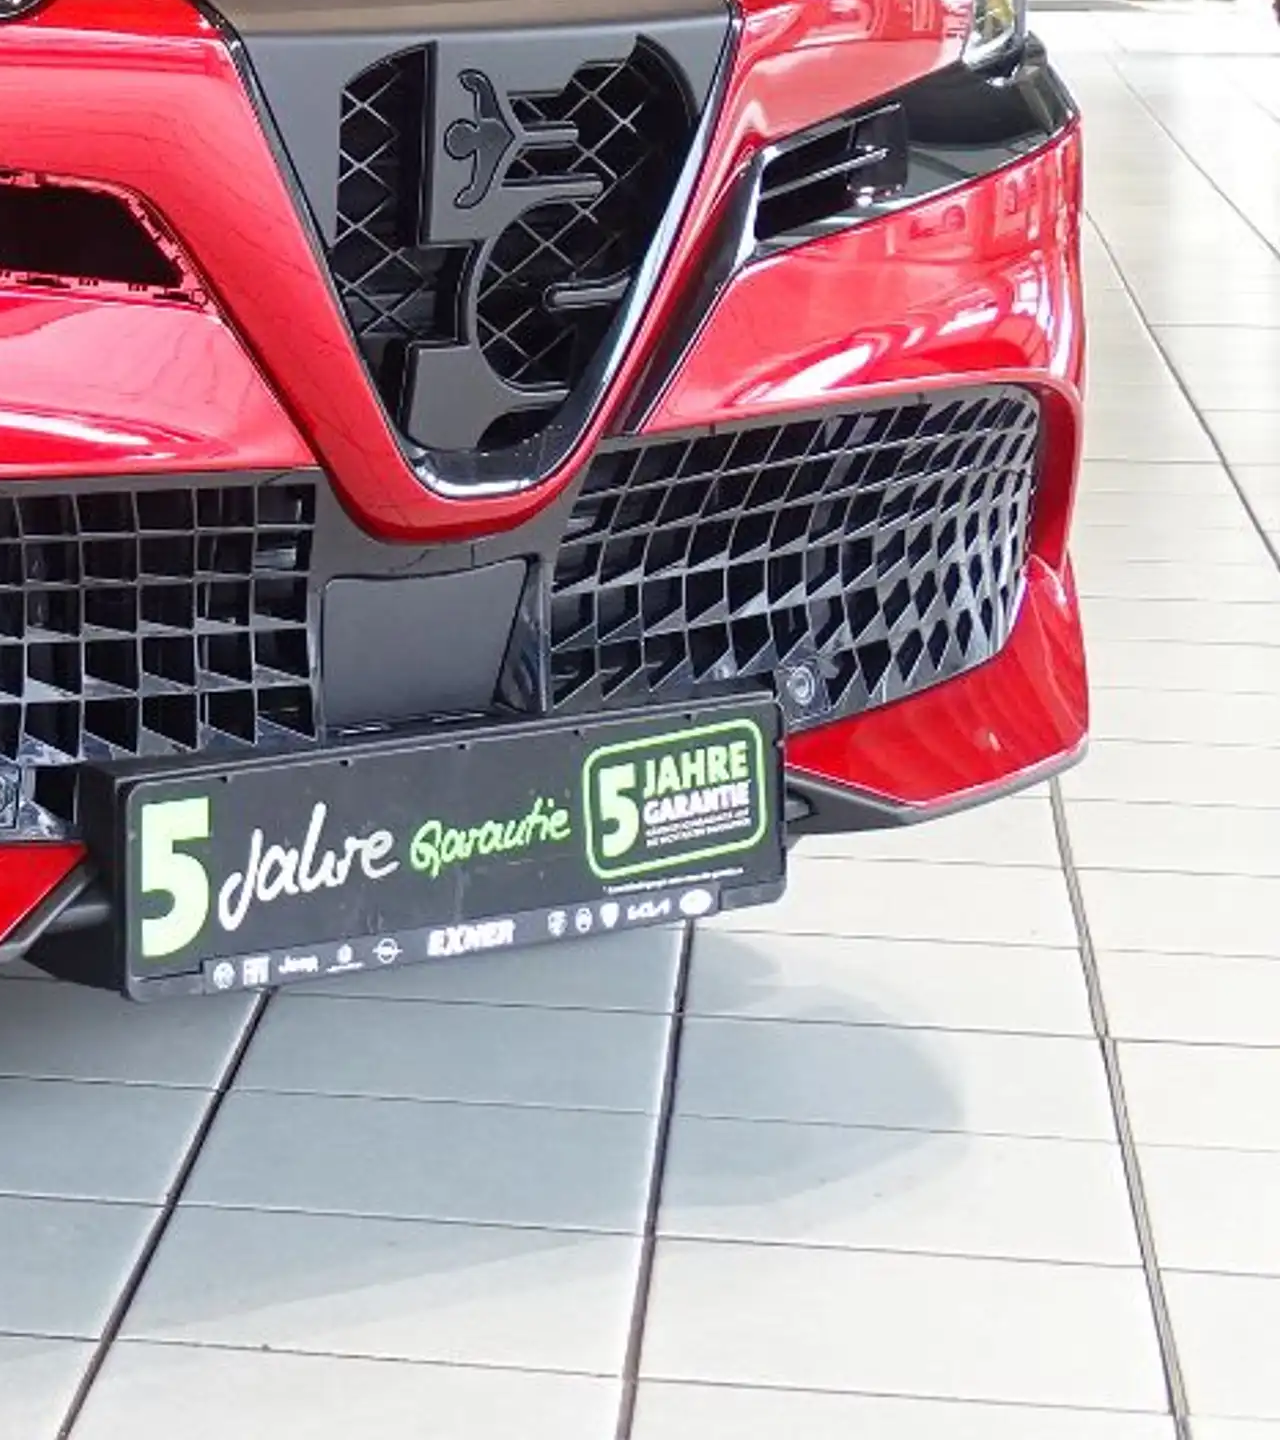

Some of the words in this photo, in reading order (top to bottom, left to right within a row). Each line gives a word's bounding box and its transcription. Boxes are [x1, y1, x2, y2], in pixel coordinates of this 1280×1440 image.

[598, 762, 640, 858] 5
[643, 740, 750, 797] JAHRE
[643, 781, 751, 826] GARANTIE
[141, 796, 210, 958] 5
[217, 801, 400, 931] Jahre
